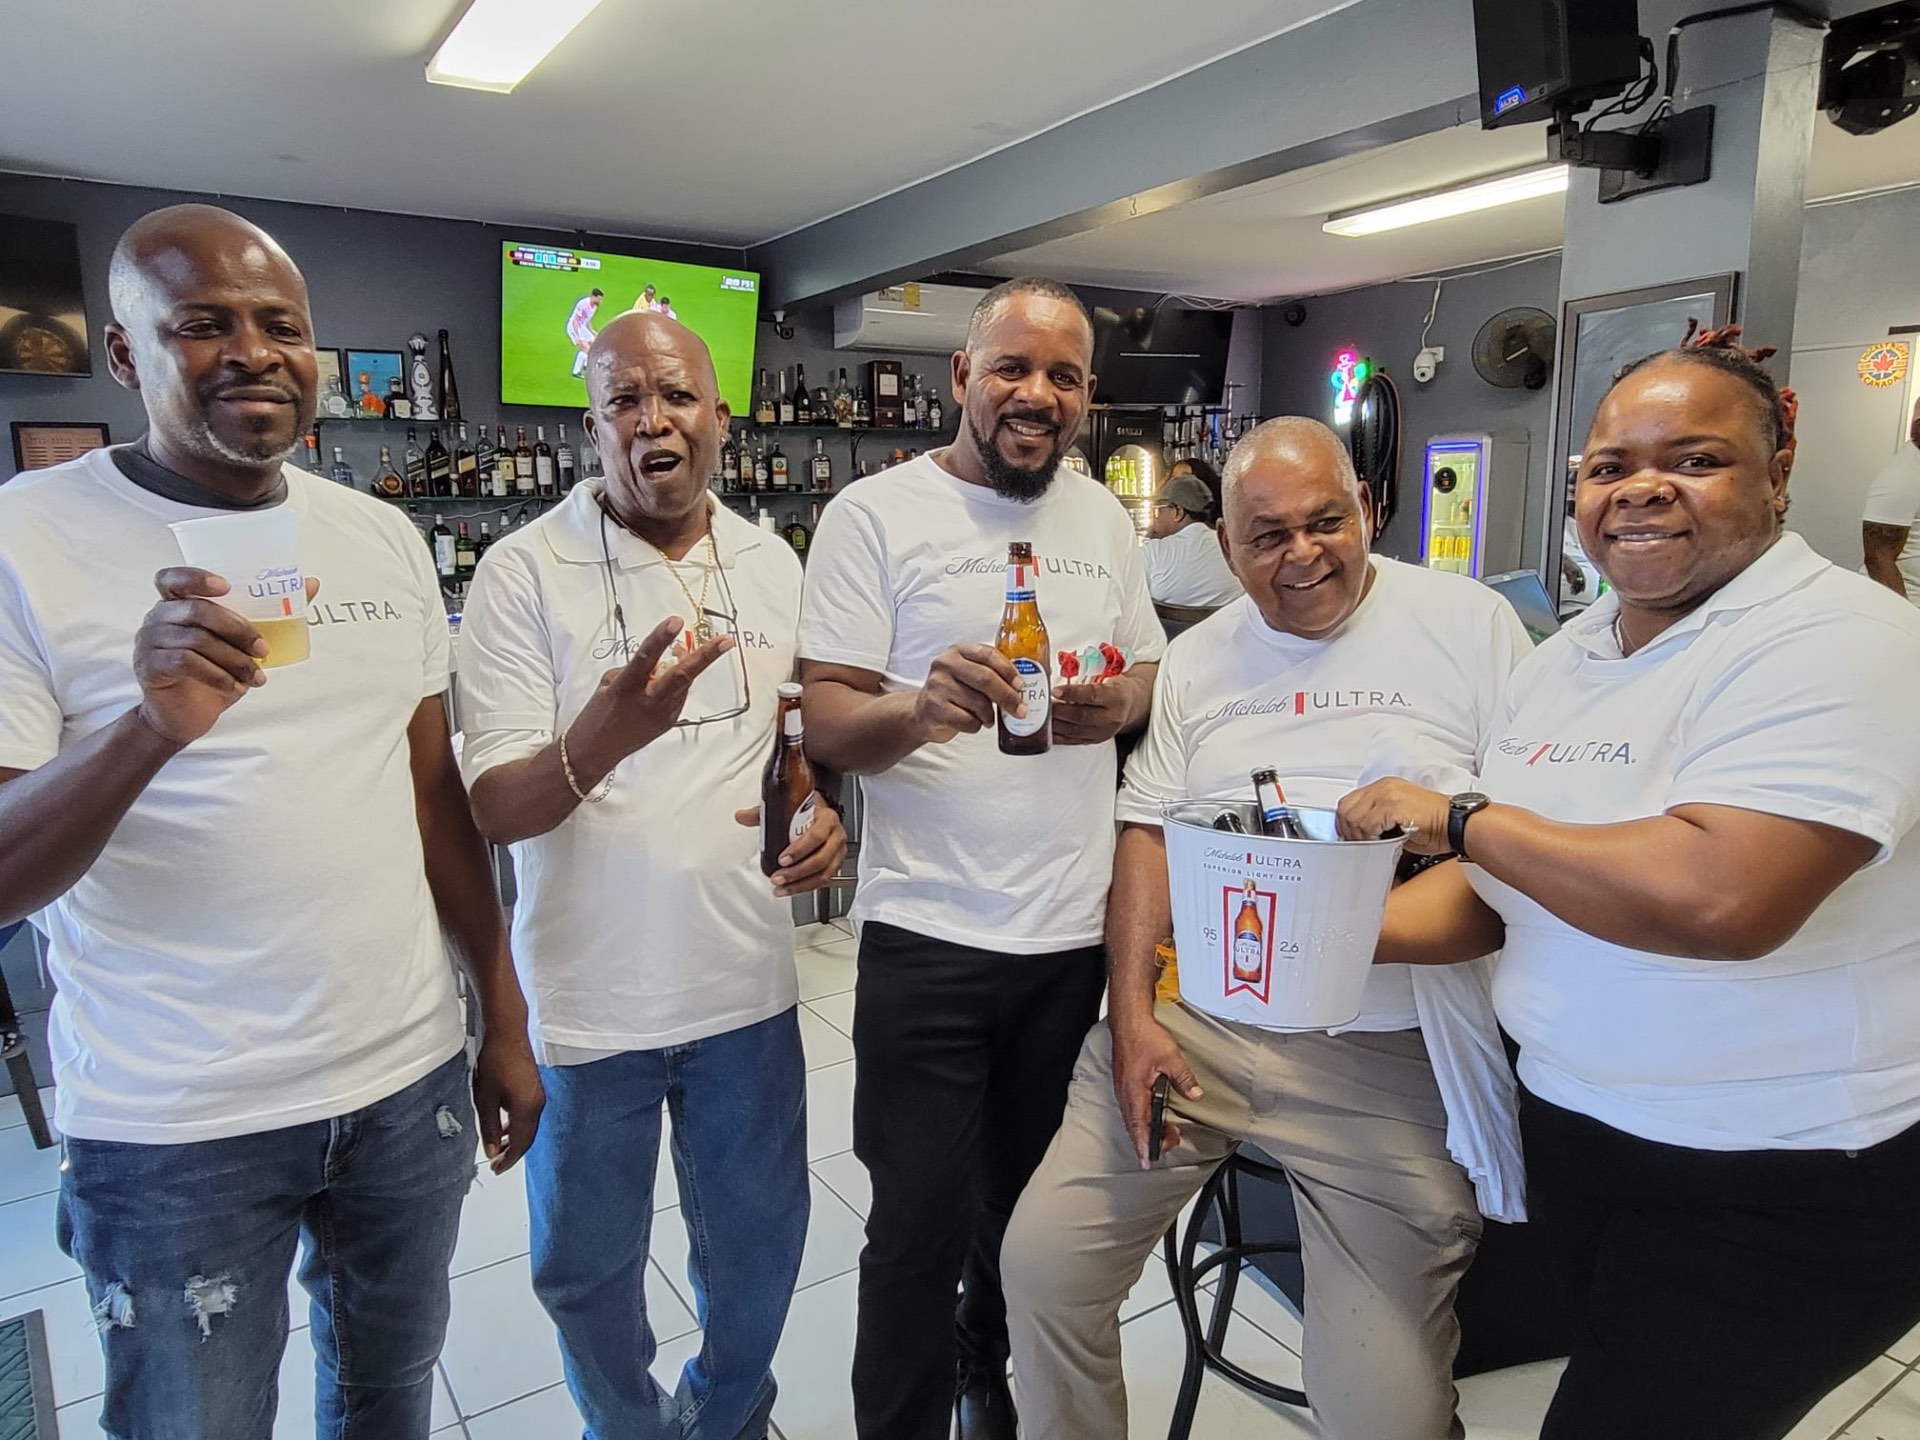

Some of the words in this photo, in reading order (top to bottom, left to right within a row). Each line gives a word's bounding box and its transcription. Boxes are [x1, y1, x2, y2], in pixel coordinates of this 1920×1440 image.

[1863, 376, 1900, 388] CANADA
[945, 556, 1009, 575] Michel
[1019, 689, 1046, 702] TRA
[1206, 695, 1290, 721] Michelob
[1203, 847, 1244, 862] Michelob
[1255, 854, 1303, 869] ULTRA
[1203, 863, 1242, 875] SUPERIOR
[1246, 871, 1274, 880] LIGHT
[1278, 874, 1303, 882] BEER
[1203, 927, 1218, 941] 95
[1235, 946, 1261, 956] ULTRA
